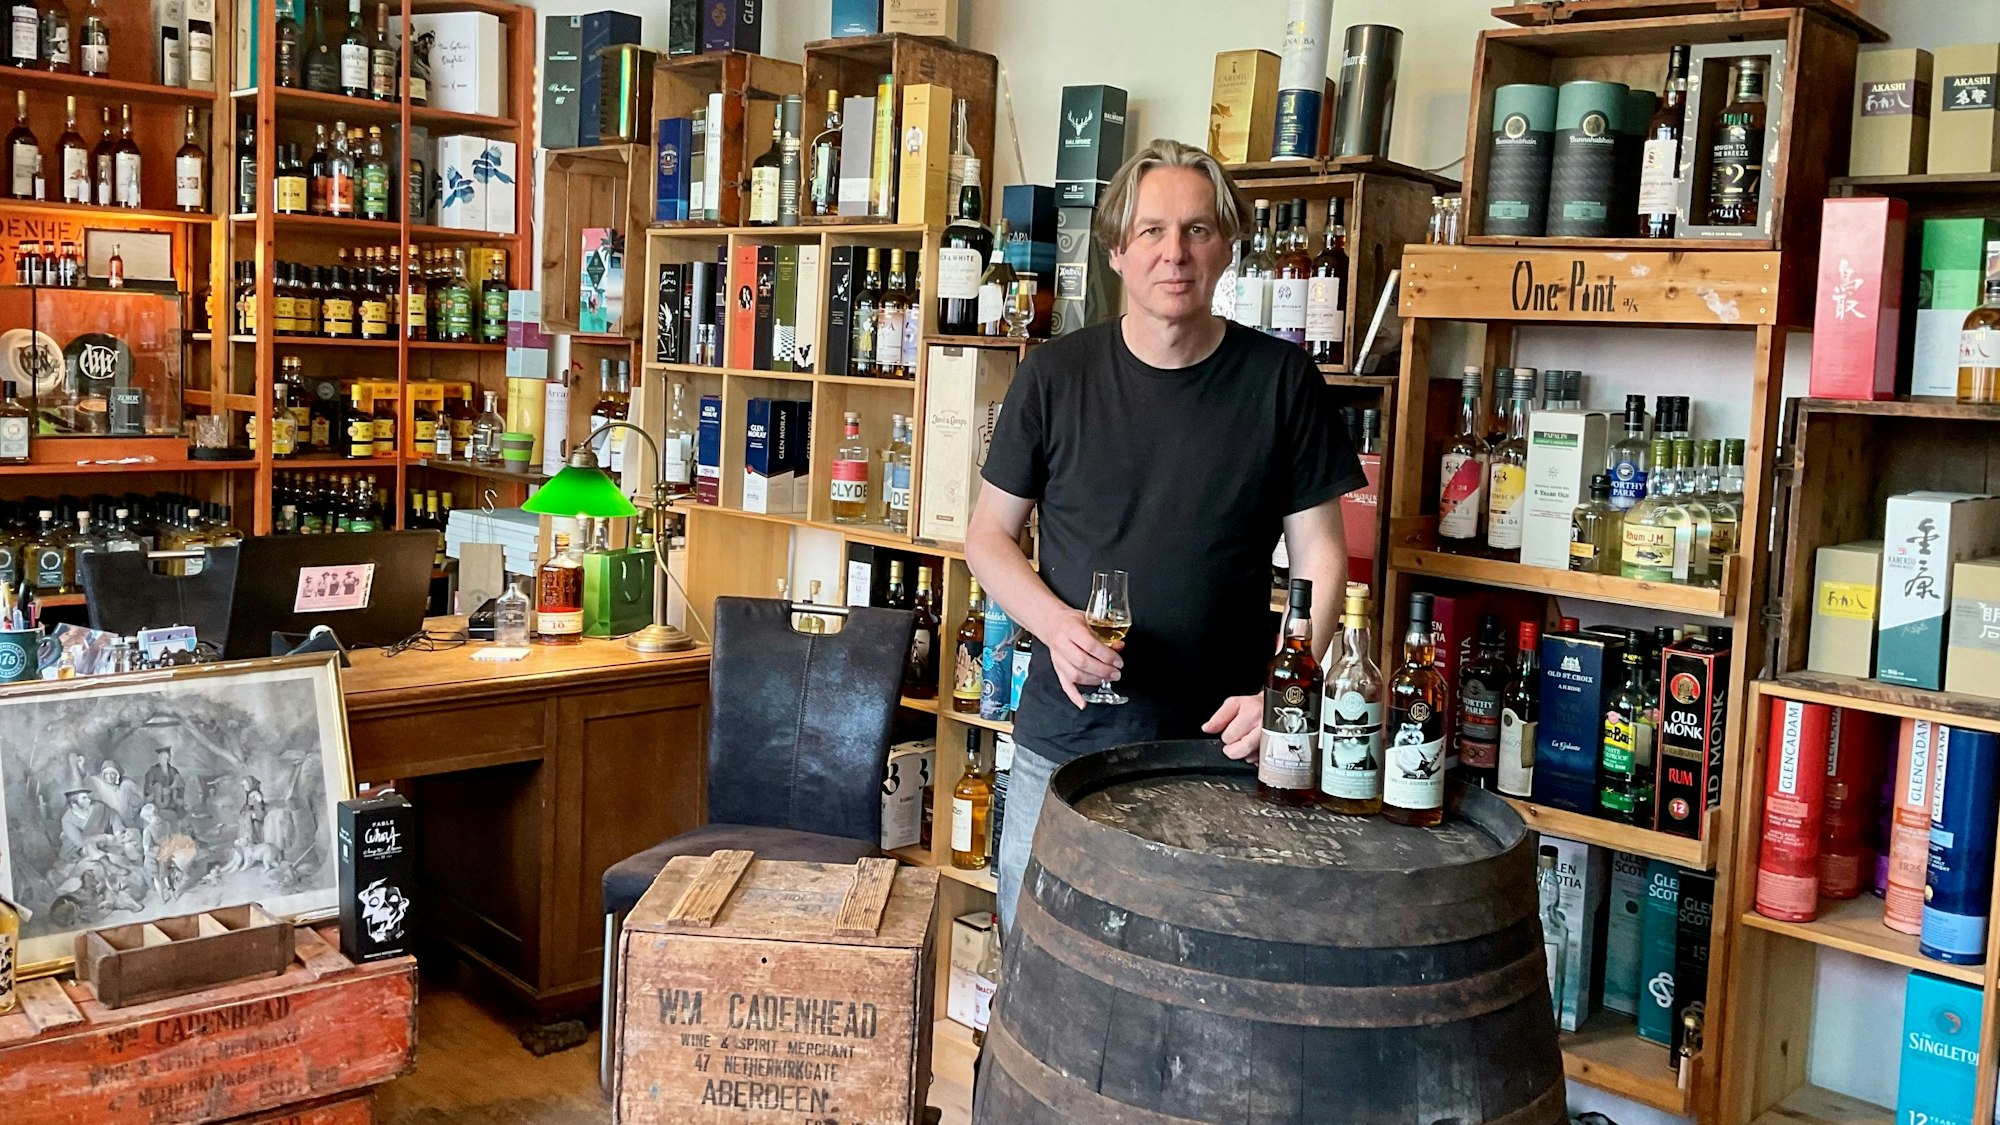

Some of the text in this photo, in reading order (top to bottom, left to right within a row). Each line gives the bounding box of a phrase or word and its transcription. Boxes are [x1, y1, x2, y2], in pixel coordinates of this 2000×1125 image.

[1217, 74, 1249, 82] CARDHU
[1953, 76, 1991, 87] AKASHI
[1872, 83, 1906, 92] AKASHI
[1865, 93, 1911, 111] あかし
[1104, 112, 1124, 122] DALMORE
[1495, 137, 1537, 145] Bunnahabhain
[1569, 135, 1614, 145] Bunnahabhain
[1512, 260, 1559, 311] One
[779, 410, 787, 440] MORAY
[747, 430, 767, 439] MORAY
[1543, 432, 1568, 440] PAPALIN
[831, 482, 867, 498] CLYDE
[1613, 488, 1636, 497] PARK
[891, 491, 909, 506] DE
[1626, 530, 1646, 543] Rhum
[1827, 591, 1868, 609] あかし
[1431, 621, 1443, 631] EN
[0, 653, 16, 666] 75
[1547, 670, 1561, 680] OLD
[1464, 706, 1485, 716] PARK
[1671, 711, 1697, 727] OLD
[1663, 721, 1703, 740] MONK
[1710, 690, 1724, 766] MONK
[1782, 705, 1800, 790] GLENCADAM
[1911, 719, 1930, 803] GLENCADAM
[1668, 767, 1693, 787] RUM
[1932, 730, 1947, 818] GLENCADAM
[1673, 803, 1685, 814] 12
[372, 819, 394, 827] FABLE
[1556, 862, 1577, 876] LEN
[1653, 872, 1679, 889] GLE
[1649, 883, 1679, 902] SCOT
[1679, 908, 1711, 928] SCOT
[155, 996, 290, 1046] CADENHEAD
[729, 992, 878, 1040] CADENHEAD
[680, 1033, 855, 1058] WINE & SPIRIT MERCHANT
[694, 1053, 839, 1082] 47 NETHERKIRKGATE
[1909, 1110, 1928, 1125] 12
